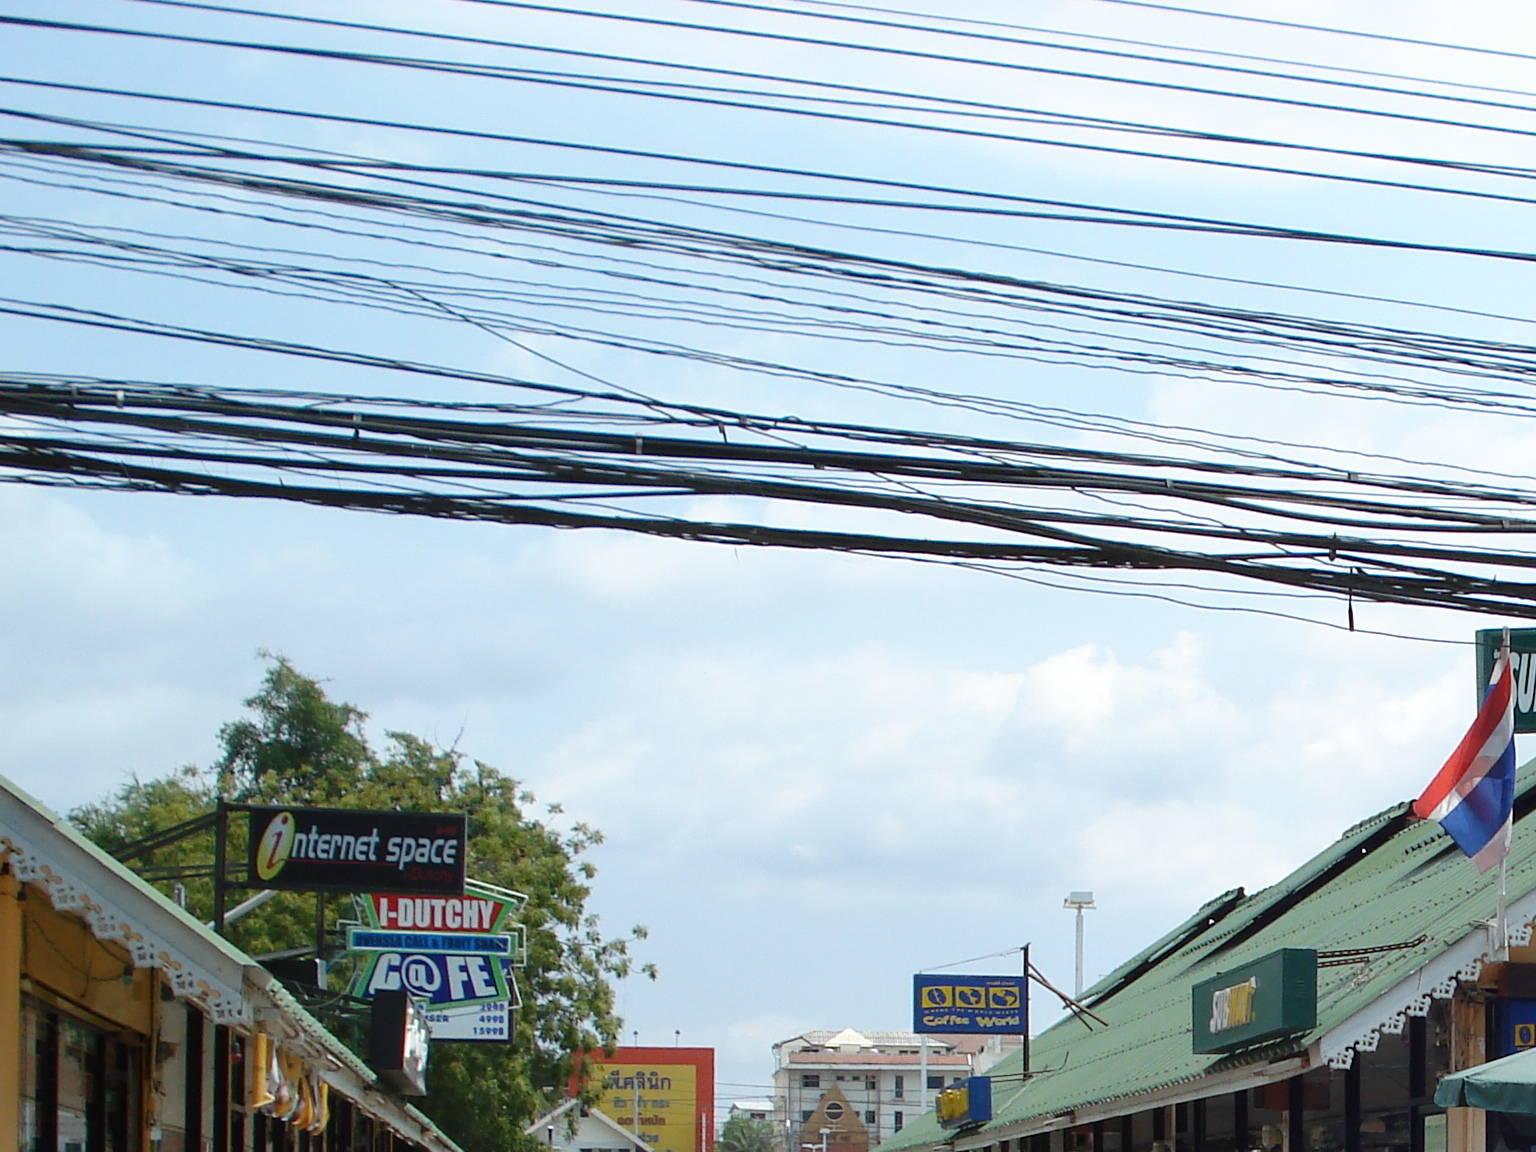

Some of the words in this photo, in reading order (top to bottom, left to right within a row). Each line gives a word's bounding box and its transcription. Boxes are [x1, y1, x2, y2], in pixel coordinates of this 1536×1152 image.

[385, 837, 457, 870] space
[378, 898, 495, 929] I-DUTCHY
[922, 1014, 970, 1027] Coffee
[975, 1015, 1021, 1028] World
